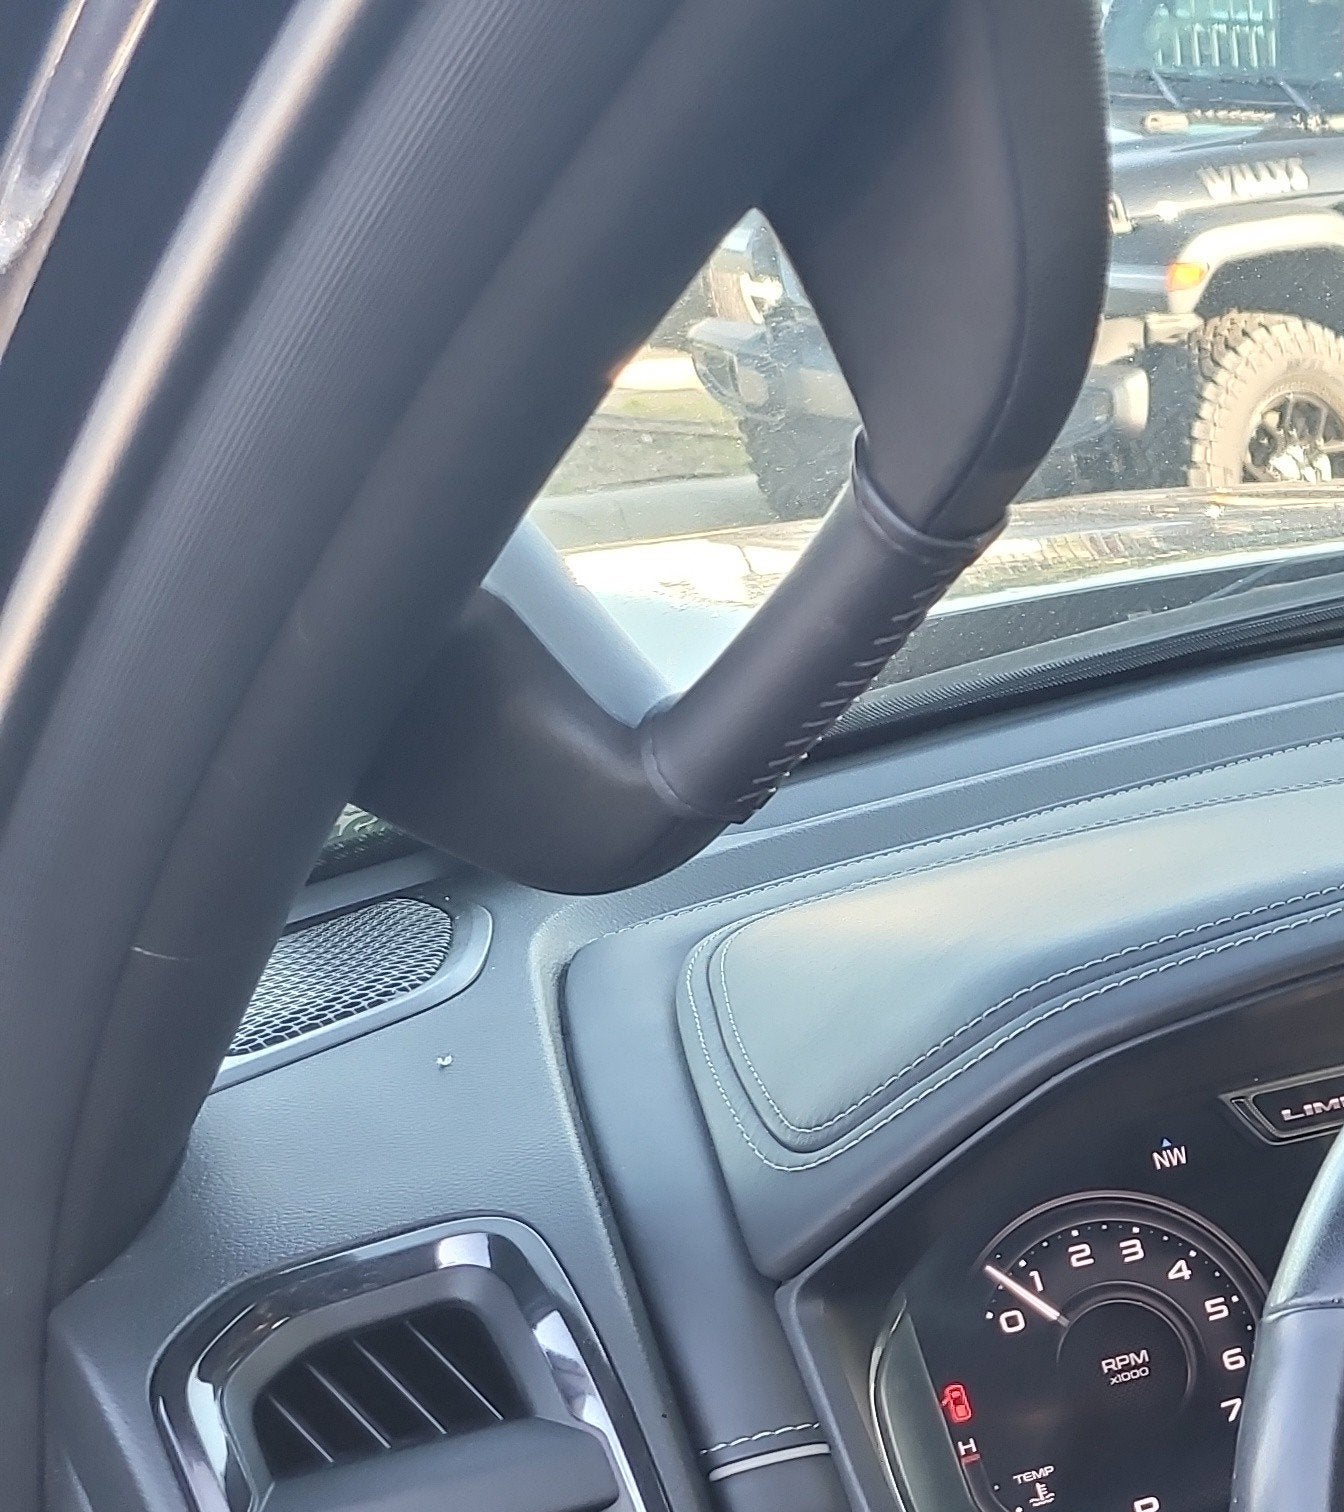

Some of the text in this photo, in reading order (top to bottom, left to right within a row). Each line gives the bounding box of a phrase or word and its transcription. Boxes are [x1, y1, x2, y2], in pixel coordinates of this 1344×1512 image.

[1153, 1145, 1188, 1170] NW
[1068, 1242, 1095, 1269] 2
[1120, 1238, 1145, 1263] 3
[1029, 1269, 1044, 1292] 1
[1167, 1259, 1192, 1282] 4
[999, 1308, 1027, 1334] 0
[1205, 1296, 1230, 1321] 5
[1102, 1349, 1150, 1374] RPM
[1222, 1347, 1246, 1370] 6
[1109, 1366, 1150, 1385] x1000
[1220, 1397, 1243, 1423] 7
[957, 1438, 978, 1456] H
[1013, 1464, 1055, 1485] TEMP
